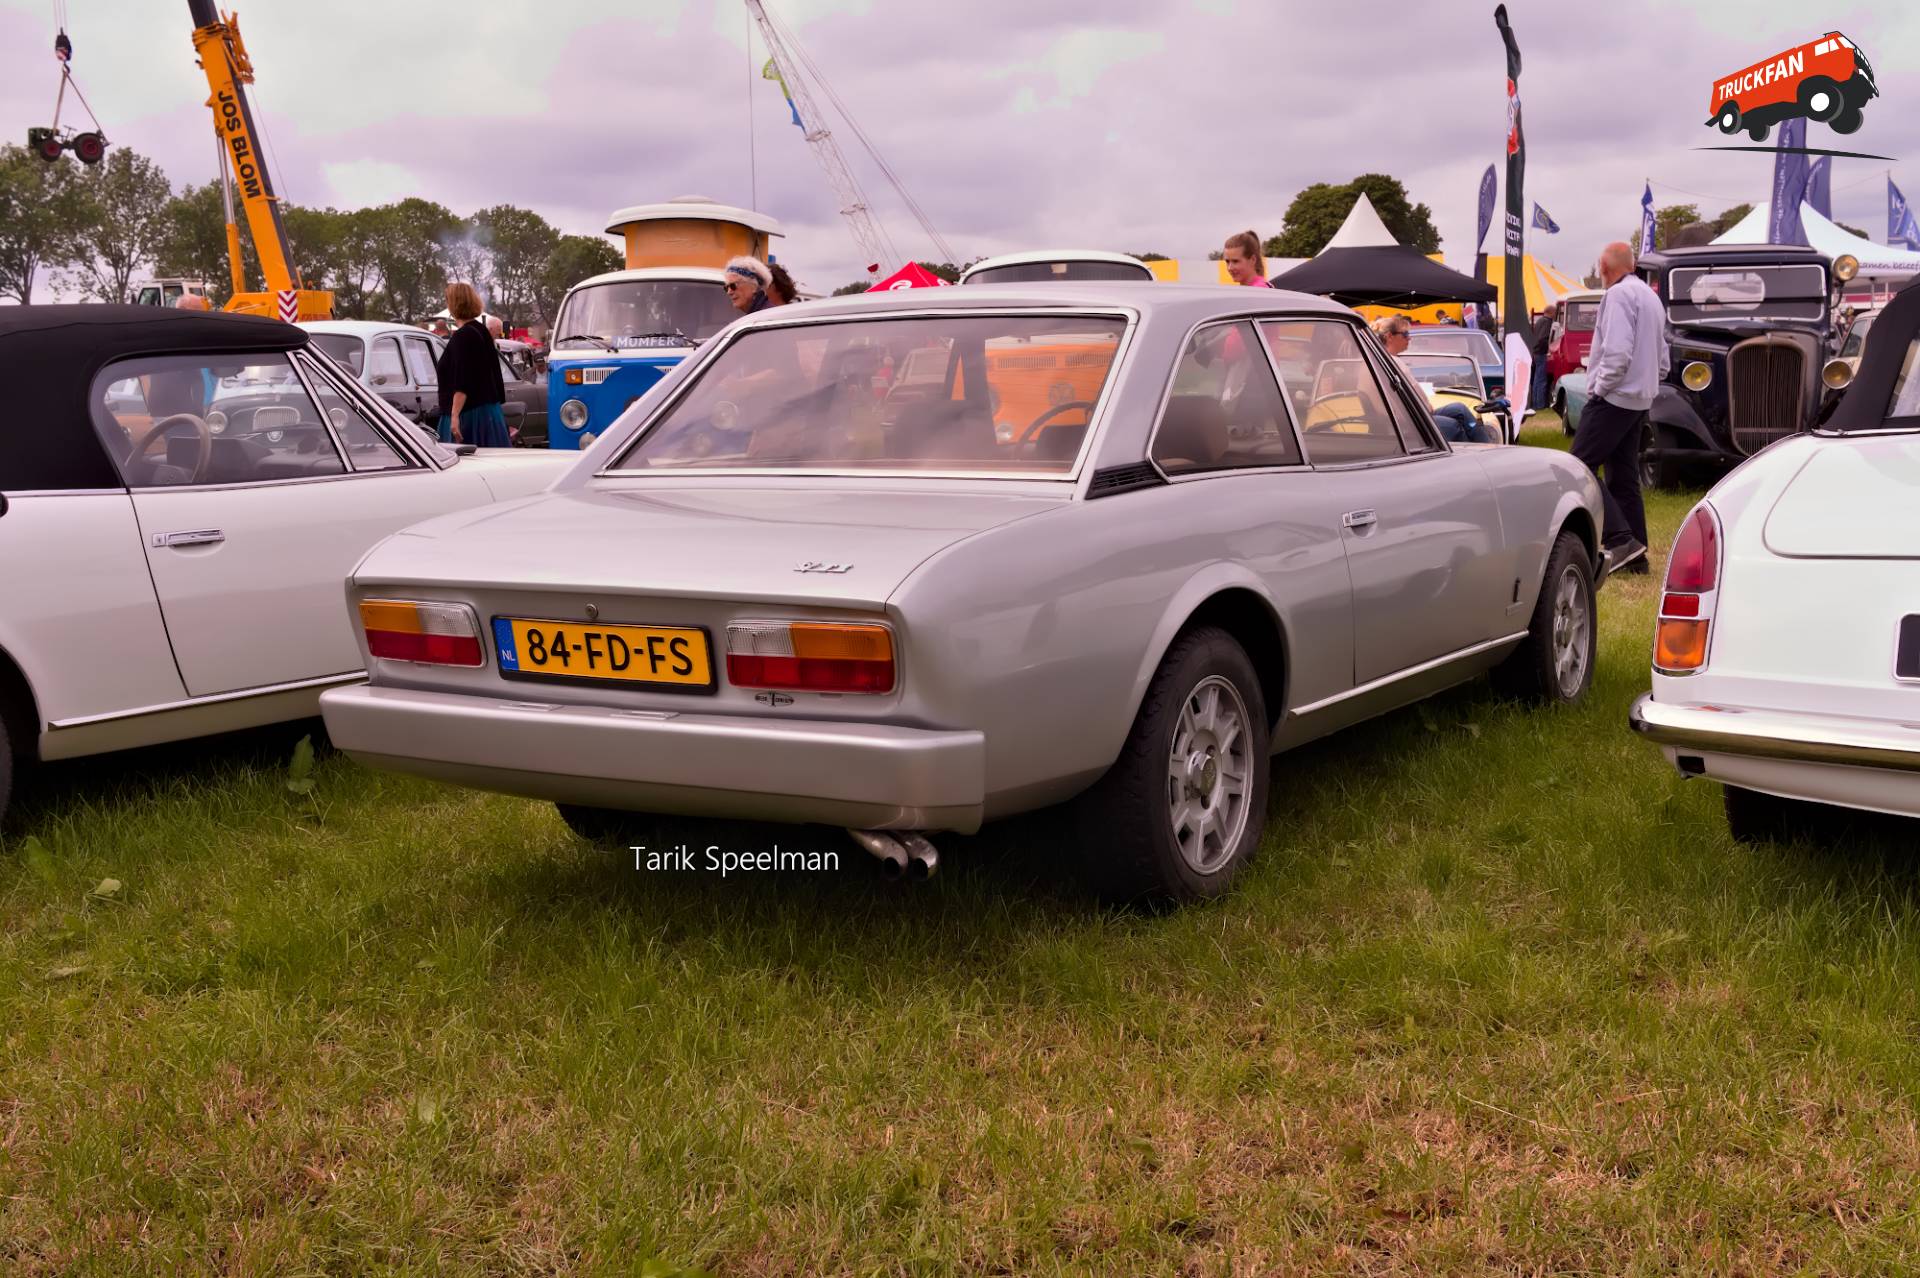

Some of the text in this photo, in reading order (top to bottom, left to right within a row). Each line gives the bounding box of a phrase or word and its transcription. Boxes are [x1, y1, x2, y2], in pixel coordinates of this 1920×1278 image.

[218, 90, 262, 199] JOS BLOM
[502, 649, 516, 662] NL
[526, 628, 693, 676] 84-FD-FS
